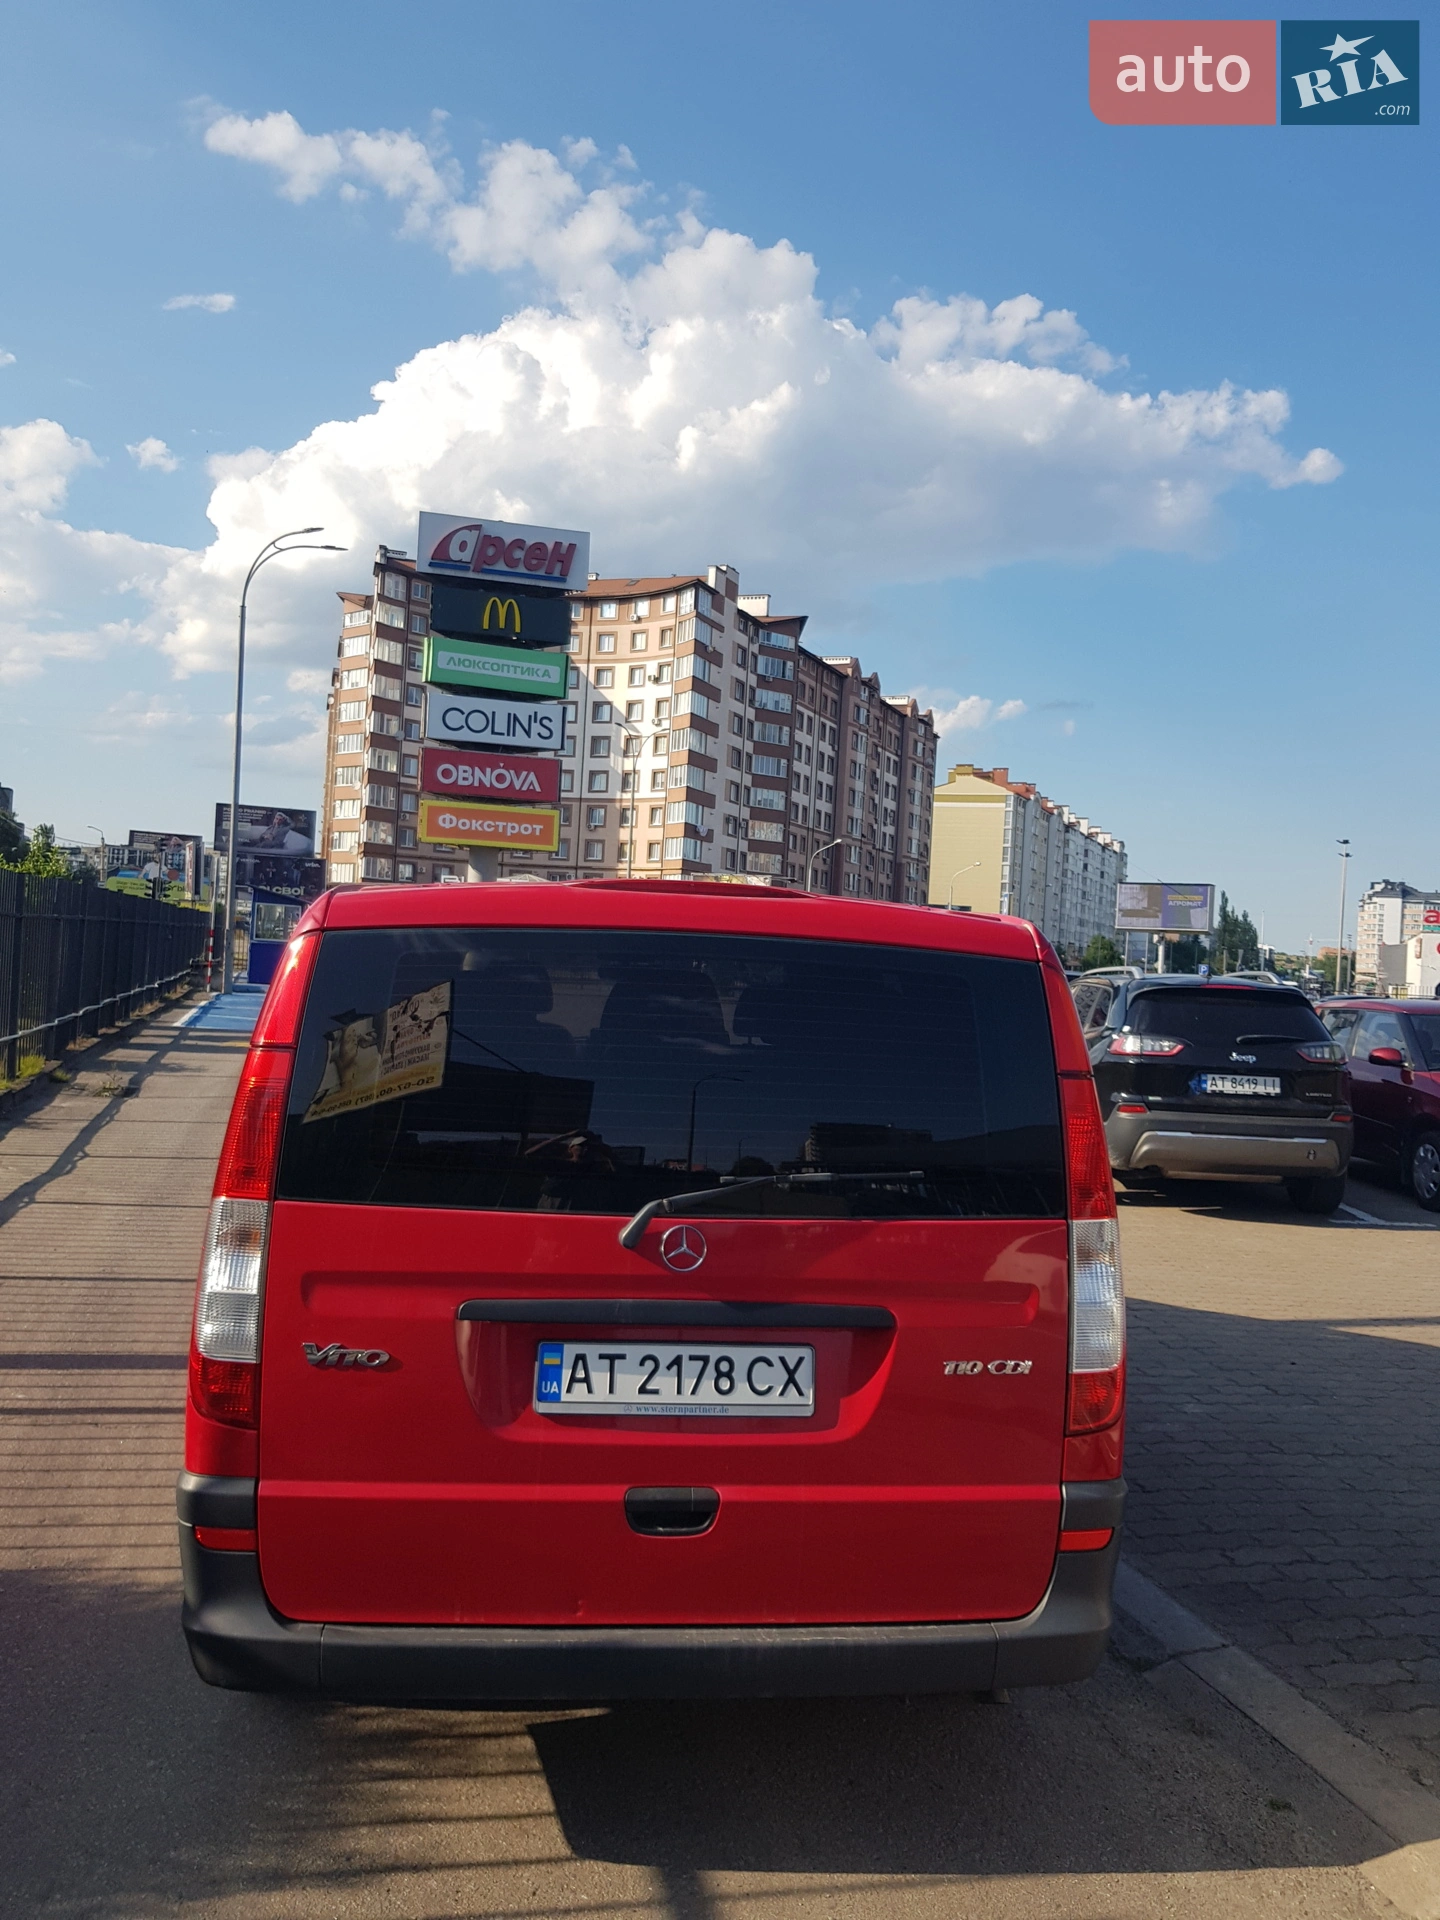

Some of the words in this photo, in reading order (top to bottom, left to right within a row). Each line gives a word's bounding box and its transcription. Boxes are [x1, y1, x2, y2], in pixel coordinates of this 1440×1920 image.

[446, 656, 552, 679] ЛЮКСОПТИКА
[442, 707, 554, 740] COLIN'S
[438, 813, 544, 836] Фокстрот
[1229, 1052, 1257, 1064] Jeep
[1209, 1076, 1228, 1089] AT
[1231, 1077, 1258, 1090] 8419
[542, 1381, 559, 1393] UA
[565, 1353, 627, 1394] AT
[638, 1354, 735, 1396] 2178
[747, 1356, 805, 1397] CX
[943, 1360, 984, 1375] 110
[636, 1404, 729, 1414] www.sternpartner.de
